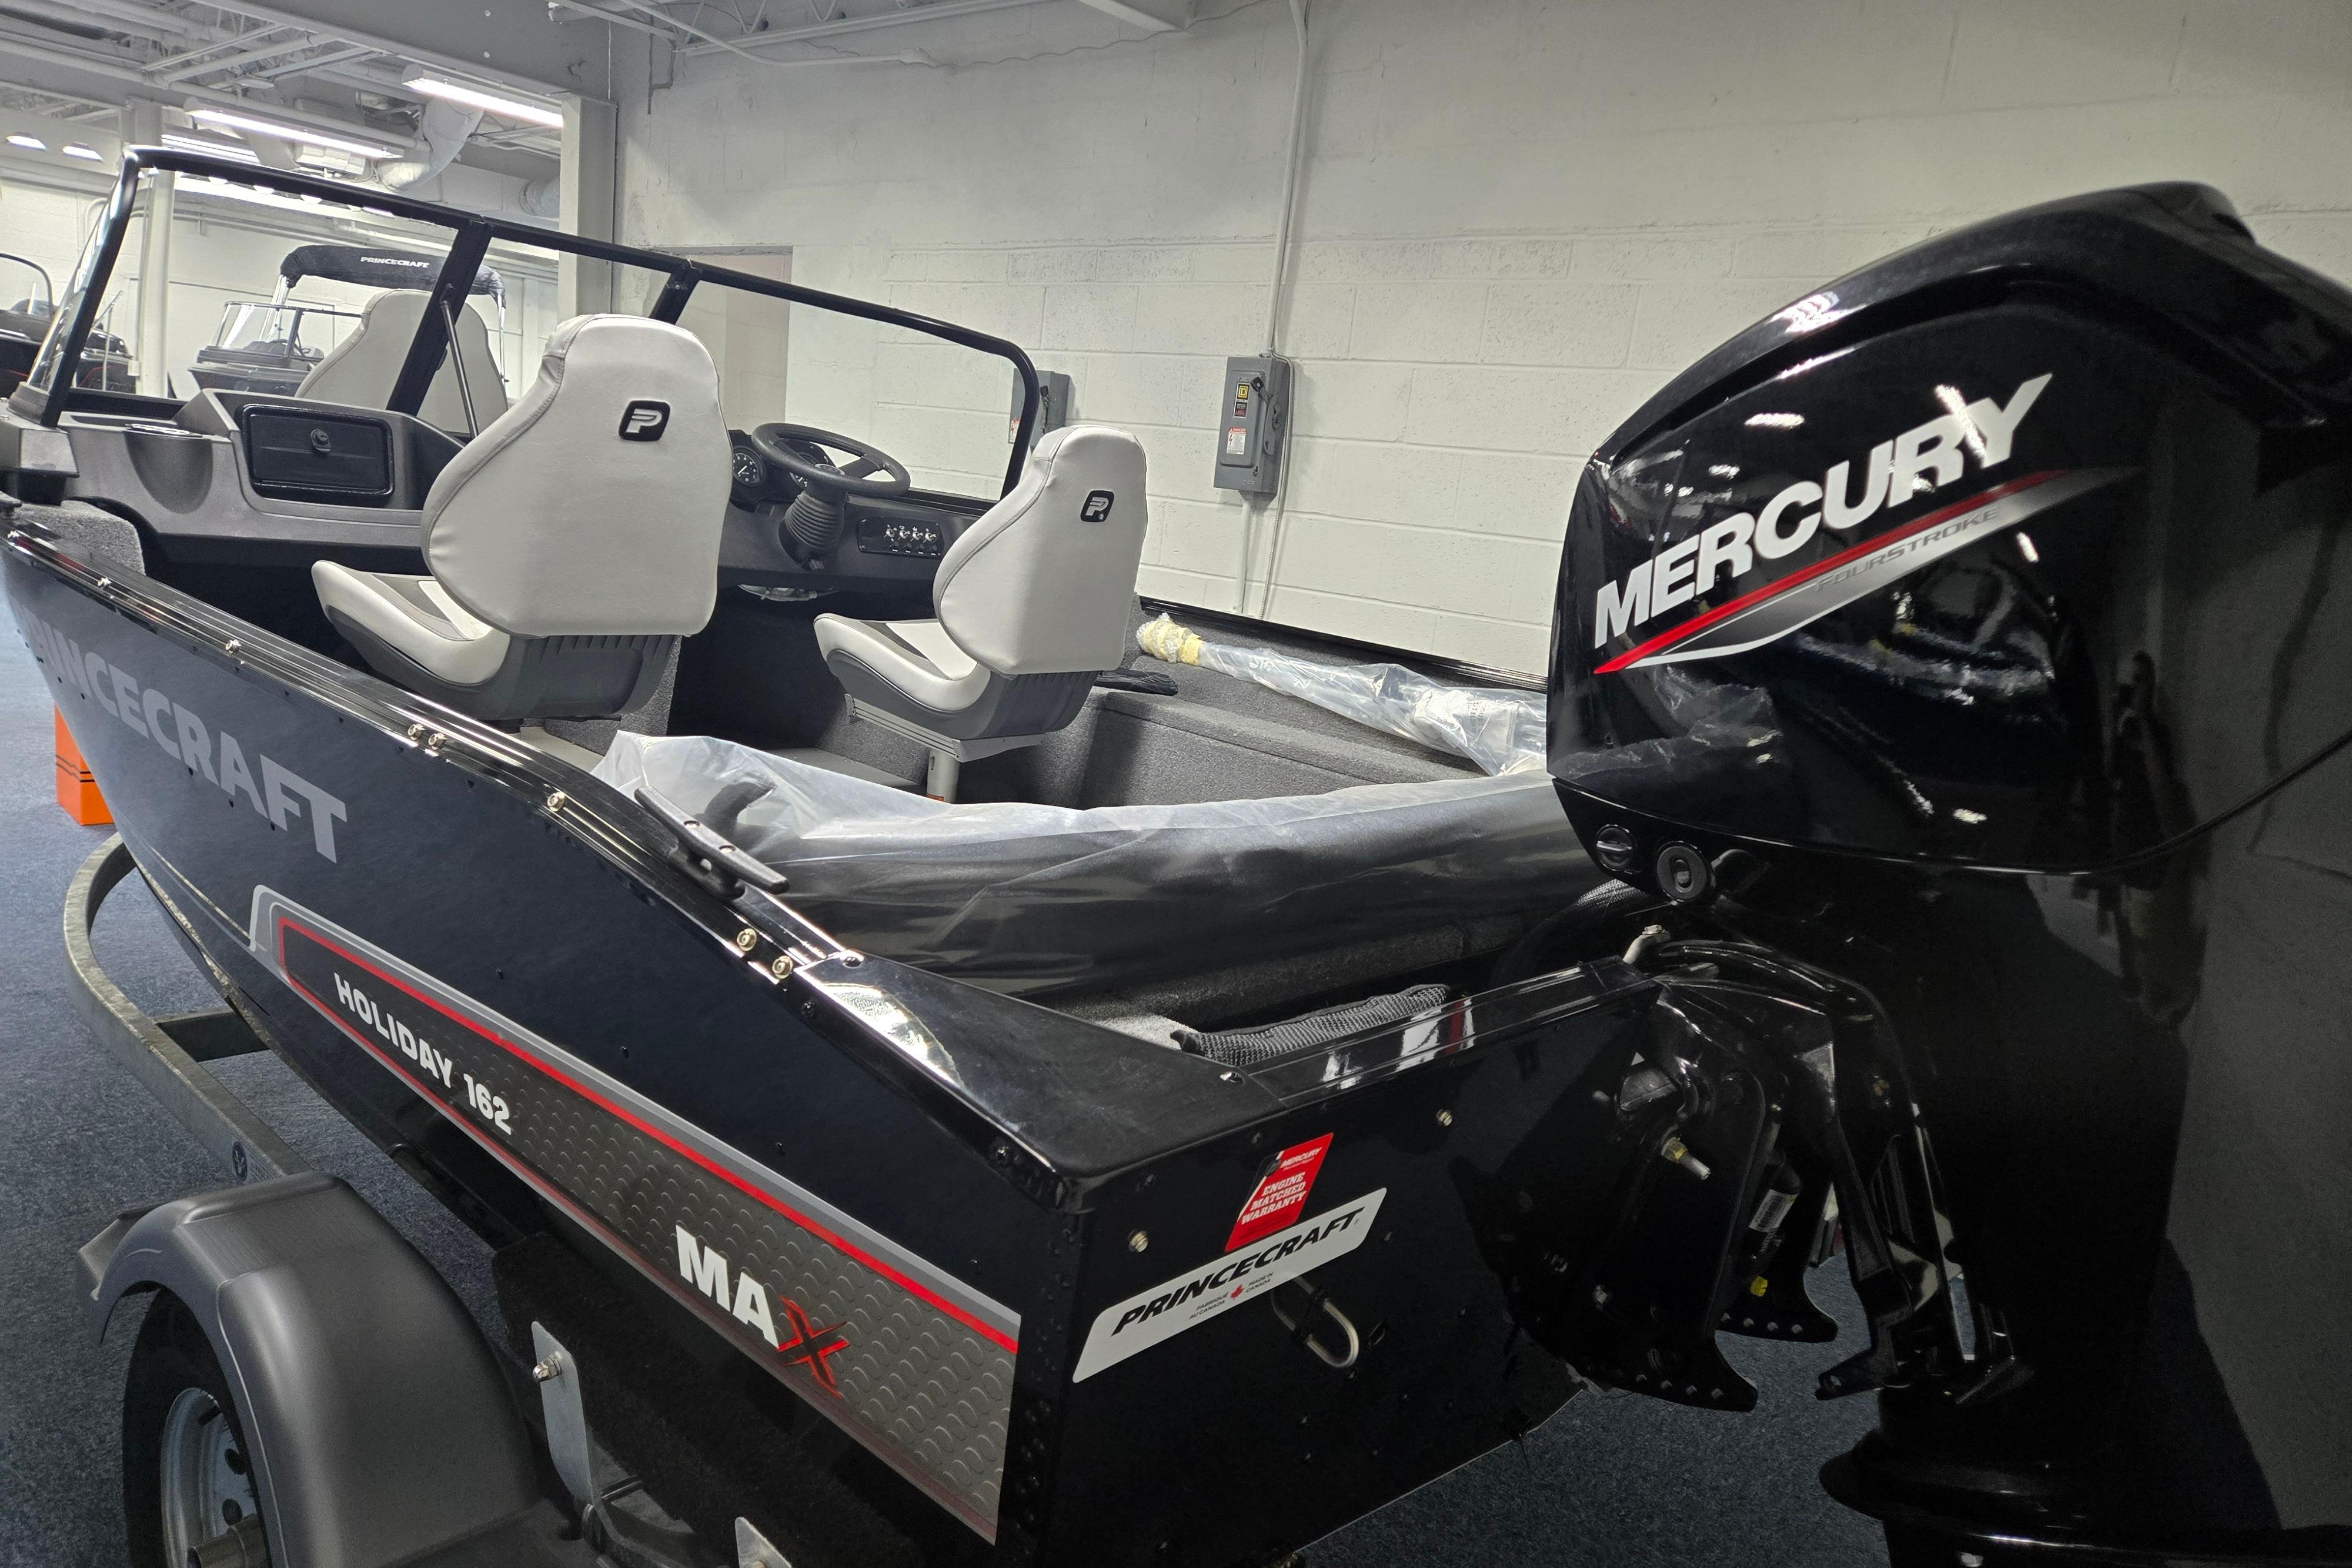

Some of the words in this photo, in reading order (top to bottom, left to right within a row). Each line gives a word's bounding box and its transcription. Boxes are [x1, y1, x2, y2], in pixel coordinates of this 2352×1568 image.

[360, 256, 430, 268] PRINCECRAFT
[1594, 373, 2053, 648] MERCURY
[1817, 507, 2000, 591] FOURSTROKE
[334, 972, 452, 1088] HOLIDAY
[463, 1073, 512, 1135] 162
[1280, 1146, 1322, 1168] MERCURY
[1250, 1181, 1307, 1211] MATCHED
[1261, 1171, 1306, 1197] ENGINE
[1242, 1190, 1308, 1225] WARRANTY
[1110, 1206, 1365, 1338] PRINCECRAFT
[1246, 1279, 1271, 1293] CANADA
[1248, 1276, 1265, 1286] MADE
[675, 1224, 851, 1400] MAX
[1199, 1300, 1225, 1315] CANADA
